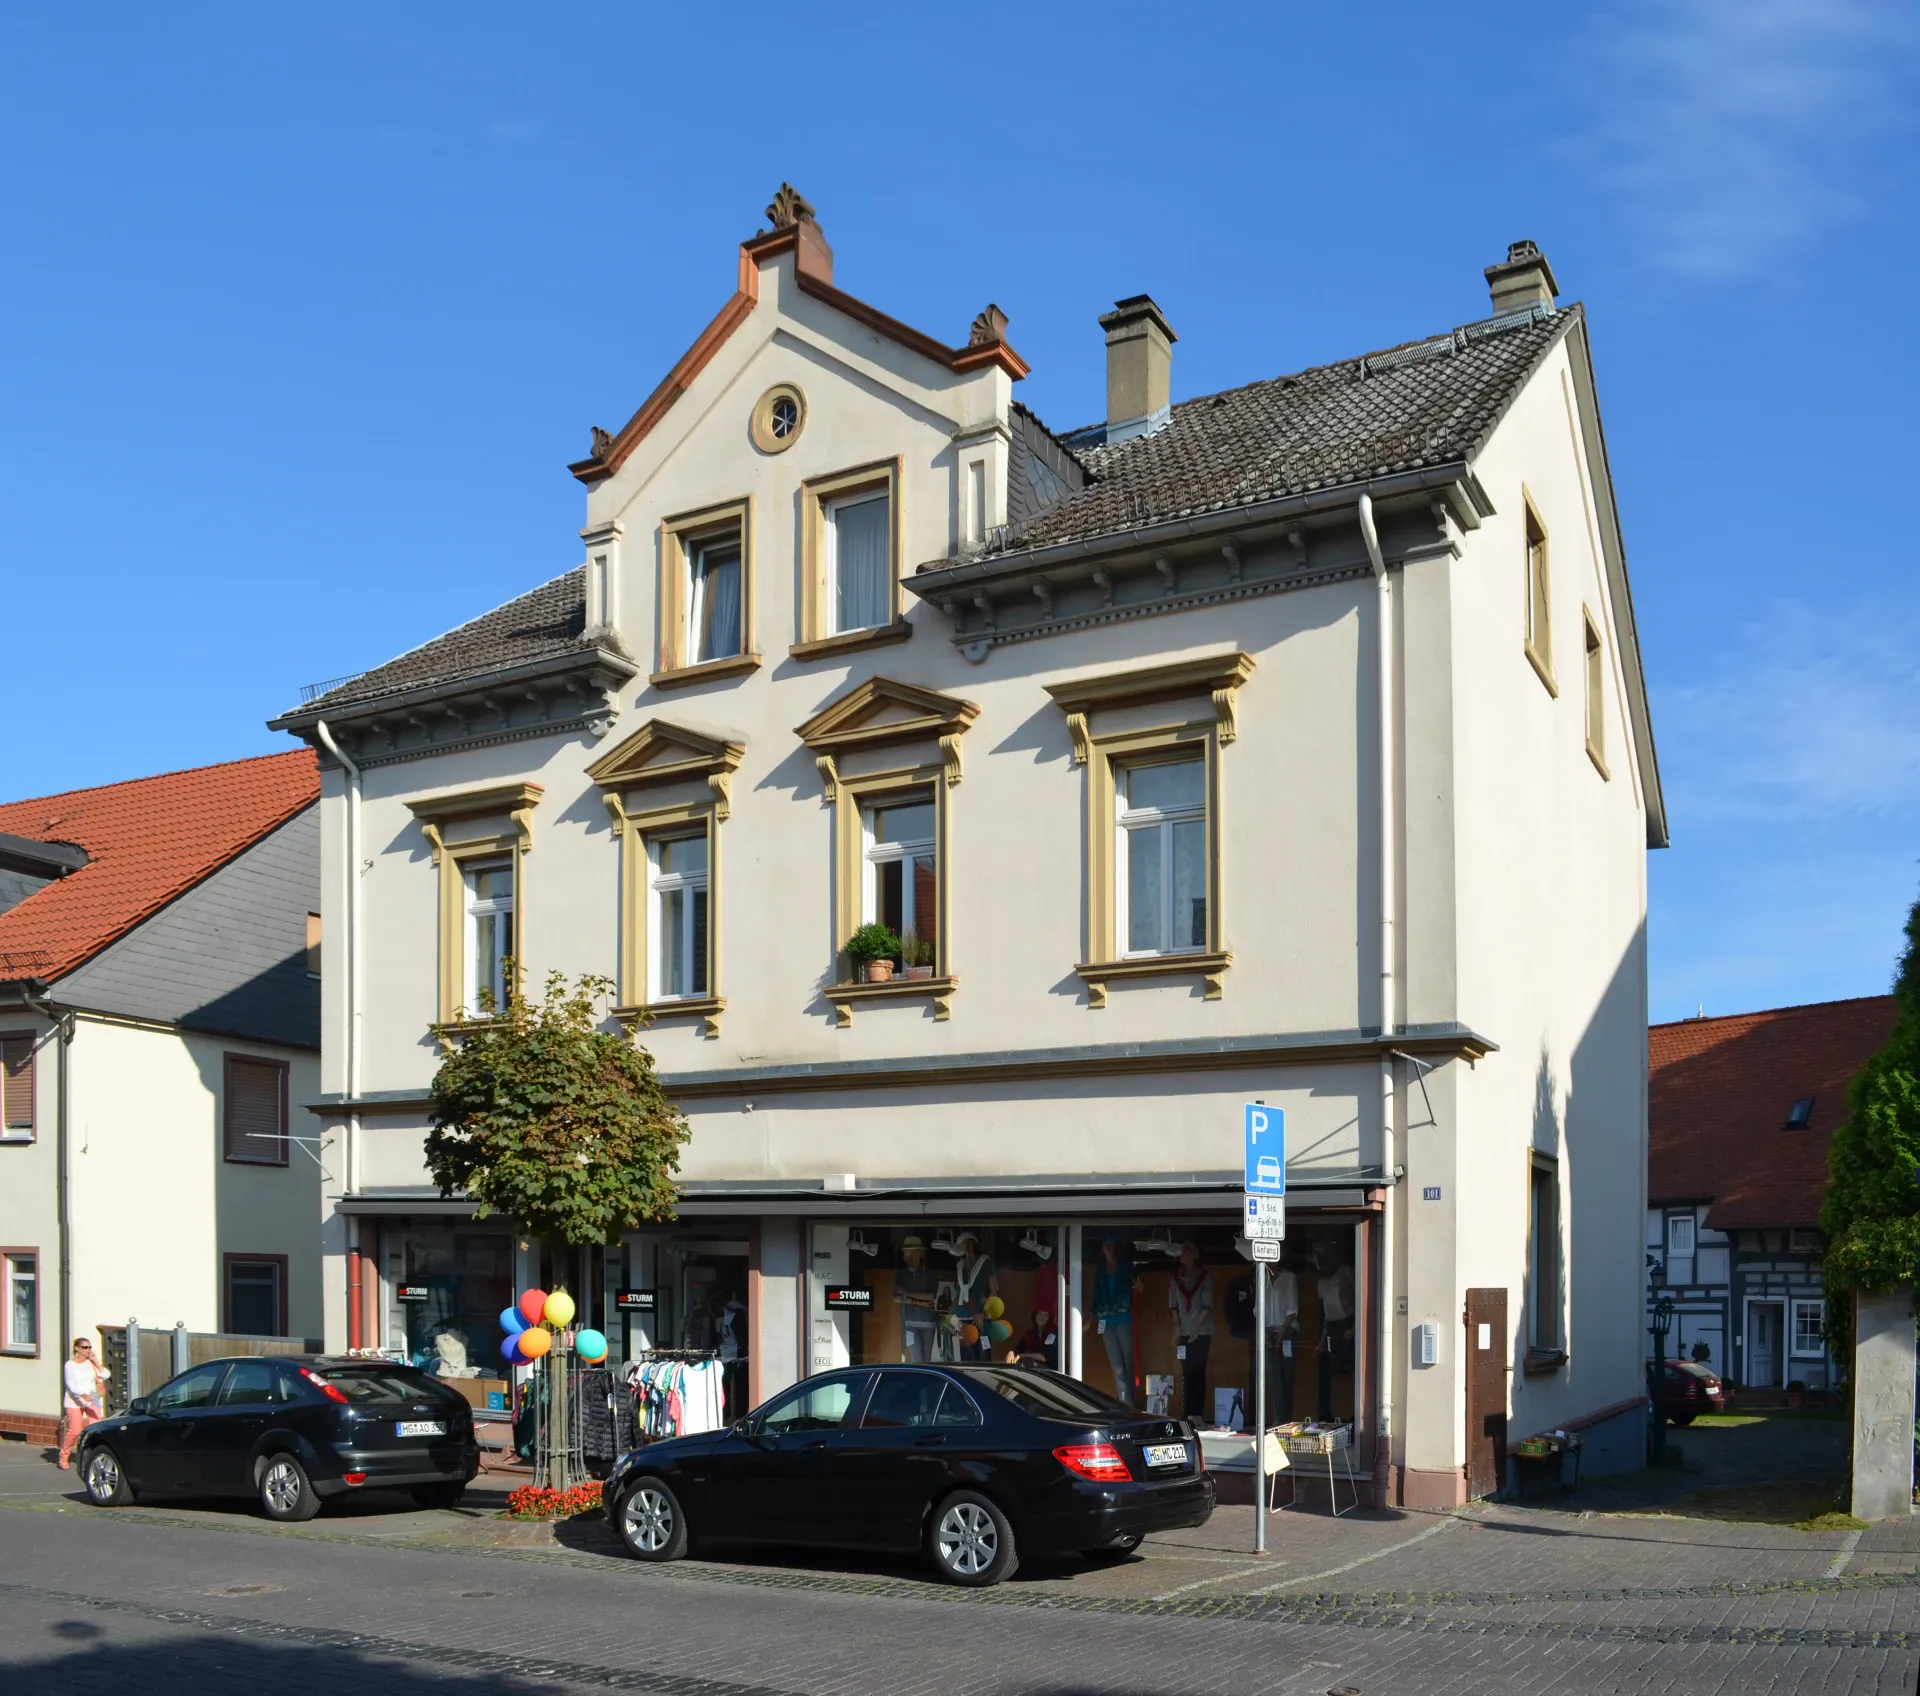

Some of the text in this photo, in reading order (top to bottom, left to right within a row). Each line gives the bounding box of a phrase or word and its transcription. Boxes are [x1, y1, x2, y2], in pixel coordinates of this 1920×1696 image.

[1251, 1110, 1269, 1145] P
[1426, 1188, 1438, 1198] 101
[1257, 1245, 1276, 1256] Anfang
[828, 1290, 870, 1300] anSTURM
[402, 1422, 446, 1433] HG AO 350
[1148, 1446, 1185, 1461] HG MC 212
